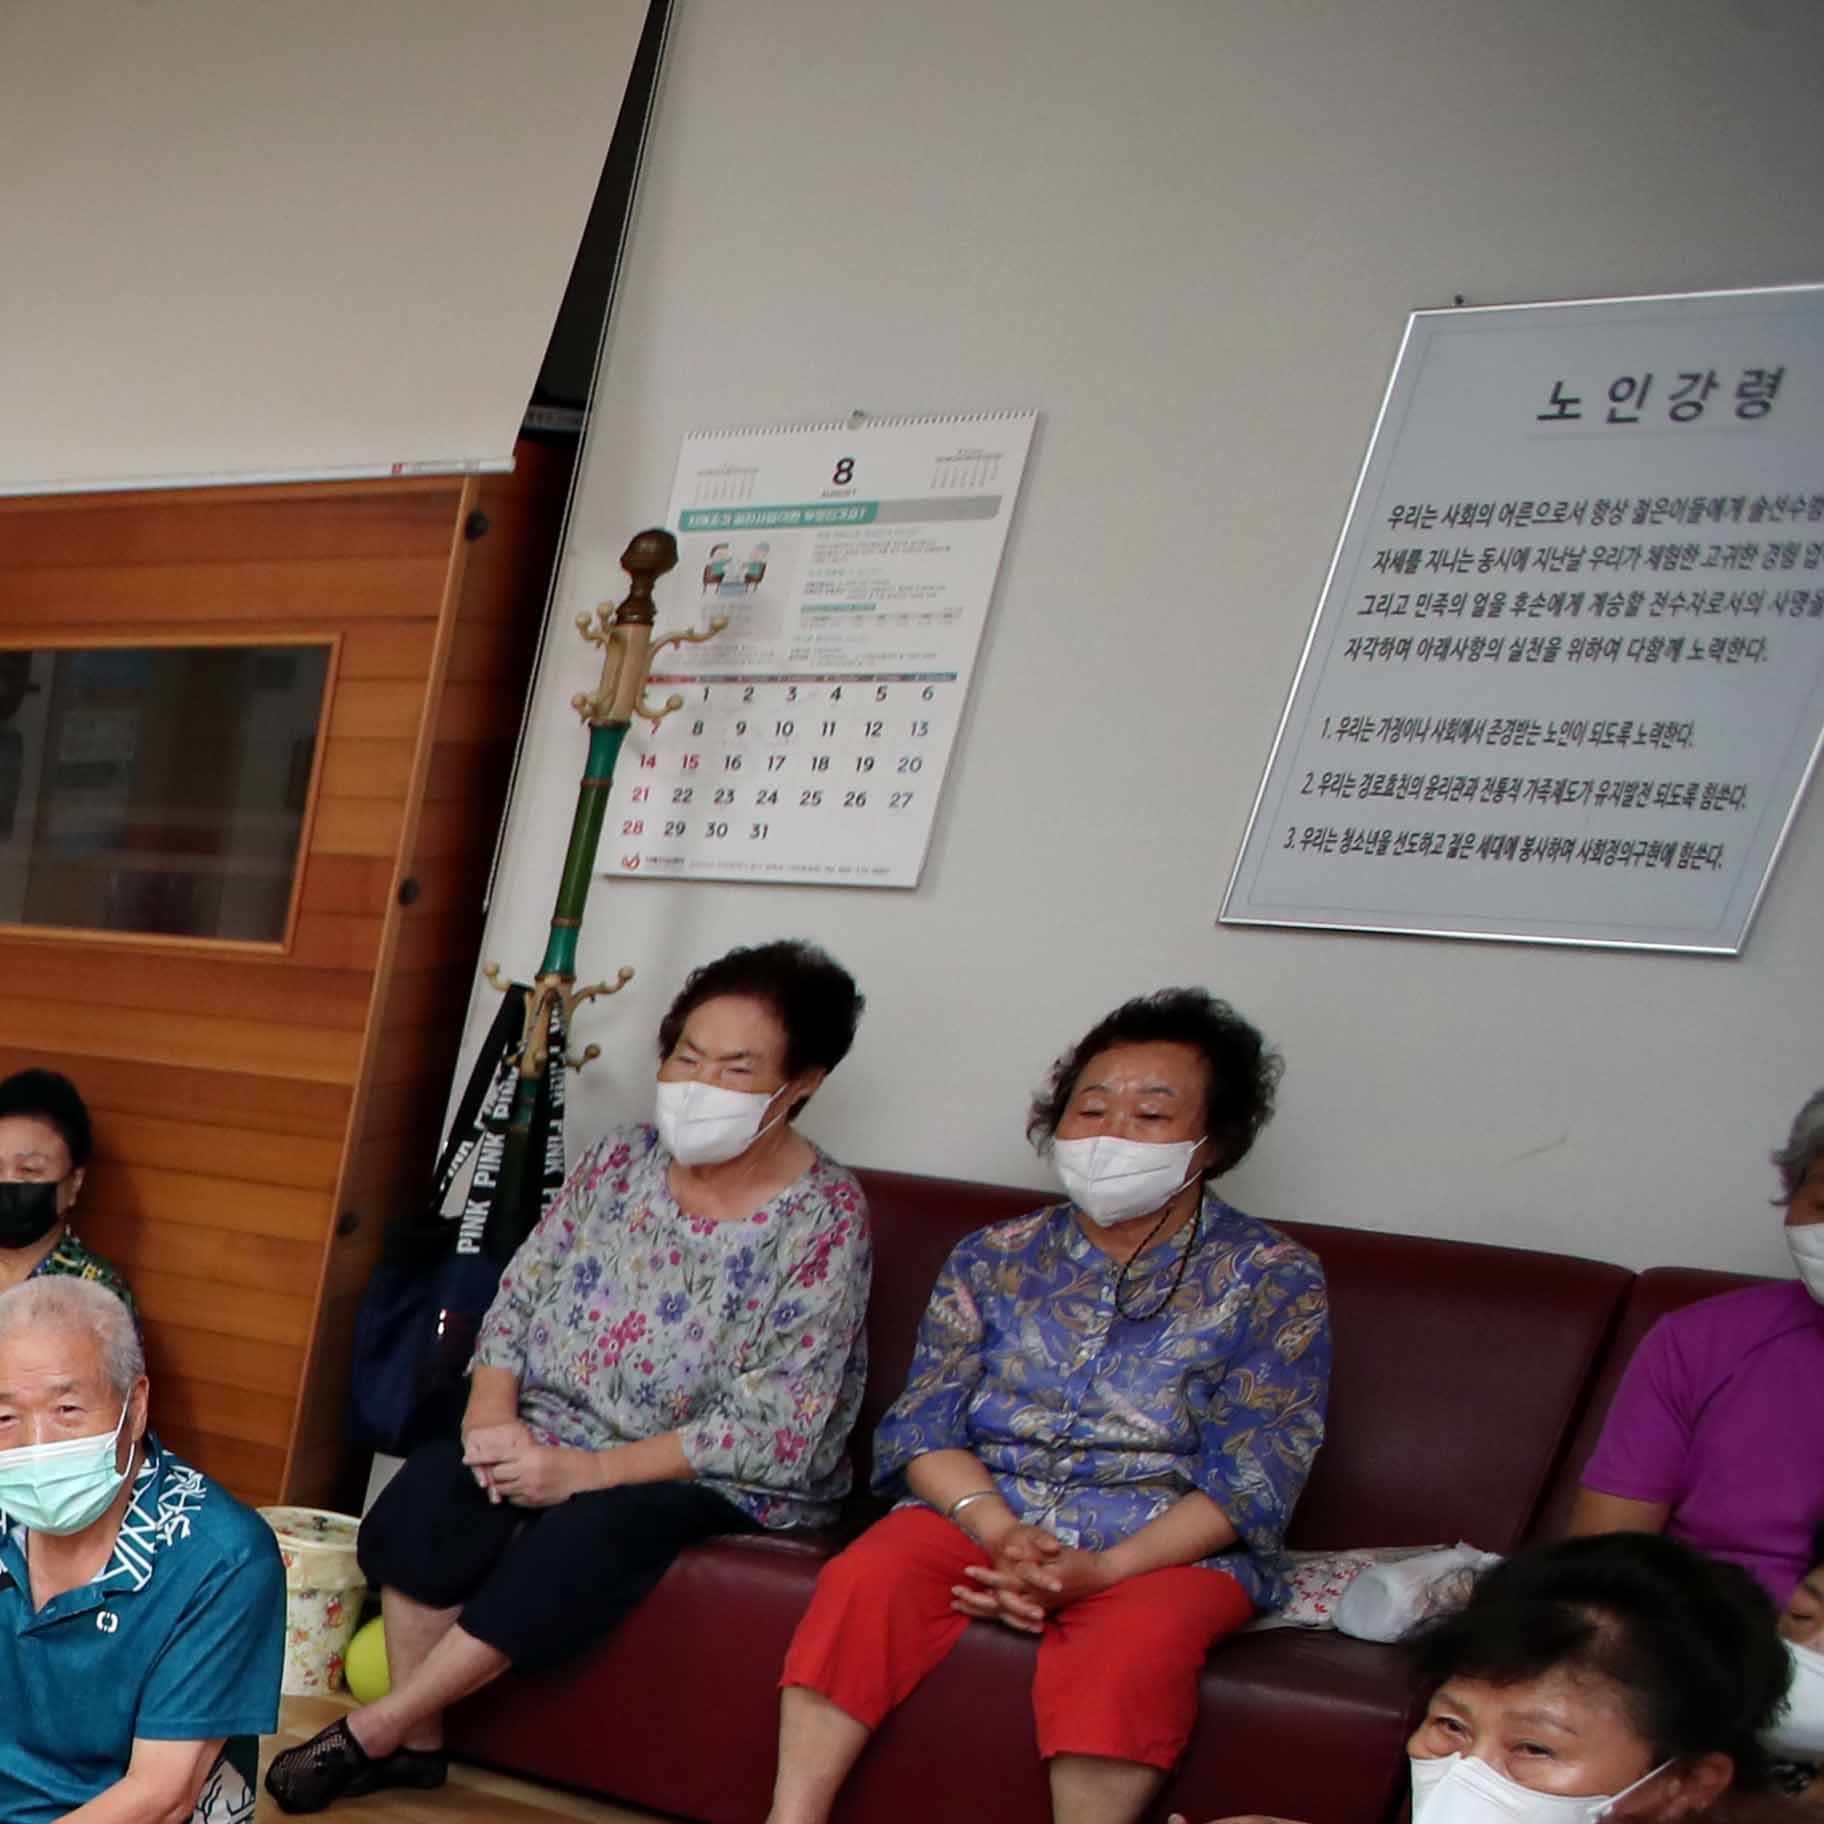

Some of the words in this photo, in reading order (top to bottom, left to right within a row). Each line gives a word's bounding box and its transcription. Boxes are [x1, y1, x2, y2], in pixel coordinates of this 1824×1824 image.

[1536, 365, 1786, 424] 노인강령
[832, 457, 855, 485] 8
[1387, 503, 1438, 531] 우리는
[1442, 501, 1495, 529] 사회의
[1498, 500, 1589, 527] 어른으로서
[1590, 498, 1630, 526] 항상
[1371, 549, 1421, 575] 자세를
[1425, 548, 1474, 573] 지니는
[1478, 546, 1530, 573] 동시에
[1532, 546, 1586, 572] 지난날
[1588, 545, 1643, 571] 우리가
[1700, 543, 1759, 570] 고귀한
[1357, 592, 1410, 618] 그리고
[1415, 592, 1467, 618] 민족의
[1510, 591, 1586, 617] 후손에게
[1344, 637, 1413, 663] 자각하며
[1416, 636, 1504, 663] 아래사항의
[1507, 636, 1563, 663] 실천을
[1567, 636, 1623, 663] 위하여
[1686, 635, 1768, 663] 노력한다.
[702, 686, 710, 702] 1
[743, 686, 754, 701] 2
[786, 686, 797, 701] 3
[830, 686, 843, 701] 4
[875, 686, 888, 702] 5
[921, 686, 934, 701] 6
[651, 718, 661, 735] 7
[691, 721, 703, 736] 8
[736, 721, 746, 737] 9
[775, 721, 794, 737] 10
[822, 721, 836, 737] 11
[865, 721, 883, 737] 12
[911, 721, 928, 737] 13
[1321, 717, 1332, 739] 1.
[1336, 716, 1375, 742] 우리는
[1376, 716, 1430, 744] 가정이나
[1431, 717, 1487, 745] 사회에서
[1486, 718, 1542, 746] 존경받는
[1543, 720, 1588, 747] 노인이
[1588, 720, 1633, 747] 되도록
[1632, 721, 1695, 749] 노력한다.
[639, 754, 657, 769] 14
[682, 754, 699, 769] 15
[724, 755, 742, 770] 16
[767, 755, 786, 771] 17
[811, 755, 830, 772] 18
[855, 755, 875, 773] 19
[897, 756, 922, 773] 20
[631, 787, 649, 803] 21
[672, 787, 693, 804] 22
[713, 788, 735, 805] 23
[756, 789, 779, 806] 24
[799, 791, 822, 807] 25
[843, 791, 867, 808] 26
[888, 792, 913, 809] 27
[1318, 771, 1356, 798] 우리는
[1424, 774, 1481, 802] 윤리관과
[1479, 776, 1522, 804] 전통적
[1523, 778, 1594, 806] 가족제도가
[1594, 779, 1654, 808] 유지발전
[1653, 782, 1700, 809] 되도록
[1699, 782, 1748, 811] 힘쓴다.
[623, 821, 644, 836] 28
[664, 821, 686, 837] 29
[705, 822, 728, 838] 30
[749, 823, 769, 840] 31
[1283, 826, 1295, 850] 3.
[1300, 827, 1337, 853] 우리는
[1340, 827, 1392, 856] 청소년을
[1392, 830, 1447, 857] 선도하고
[1447, 831, 1476, 859] 젊은
[1476, 833, 1520, 861] 세대에
[1519, 836, 1578, 864] 봉사하며
[1677, 841, 1725, 871] 힘쓴다.
[473, 1131, 507, 1188] PINK
[456, 1200, 491, 1254] PINK
